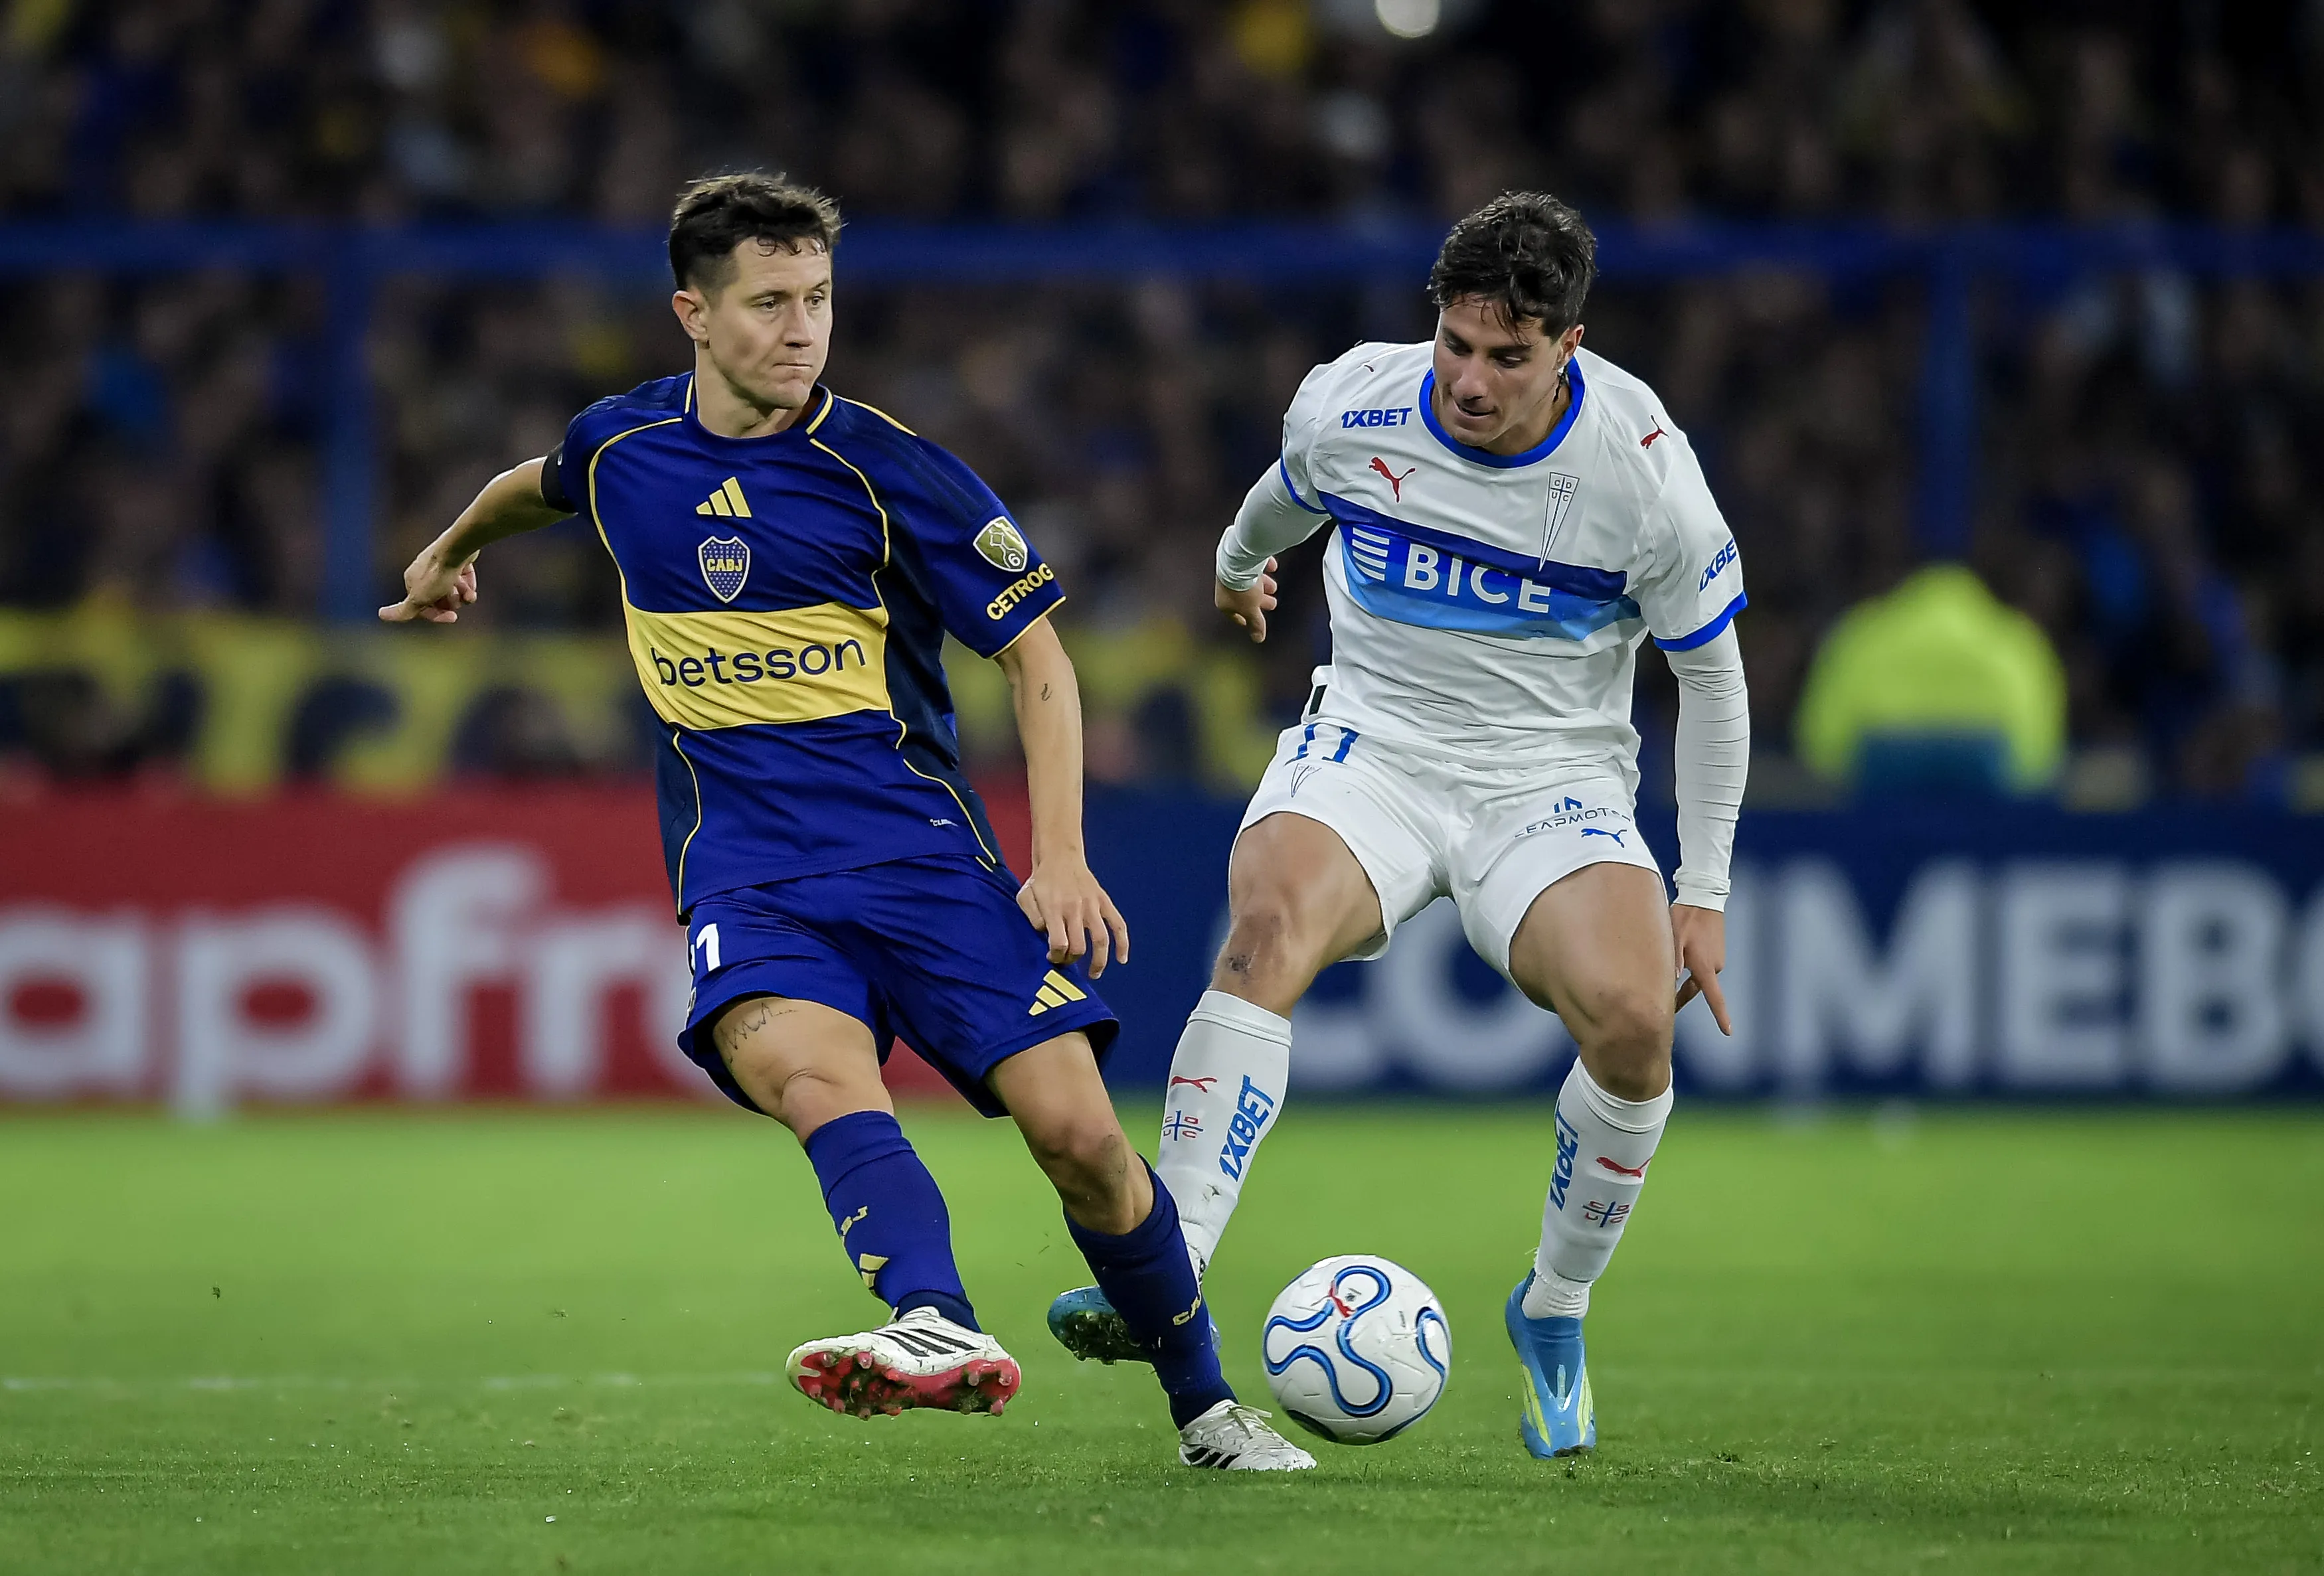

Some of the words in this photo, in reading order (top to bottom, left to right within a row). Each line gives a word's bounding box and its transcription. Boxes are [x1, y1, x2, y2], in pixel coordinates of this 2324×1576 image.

[1341, 407, 1413, 428] 1XBET
[706, 559, 743, 572] CABJ
[1008, 553, 1021, 566] 6
[1404, 543, 1551, 613] BICE
[987, 563, 1054, 620] CETROG
[650, 639, 867, 687] betsson
[690, 923, 722, 972] 1
[0, 836, 720, 1125] apfr
[1219, 1073, 1274, 1182] 1XBET
